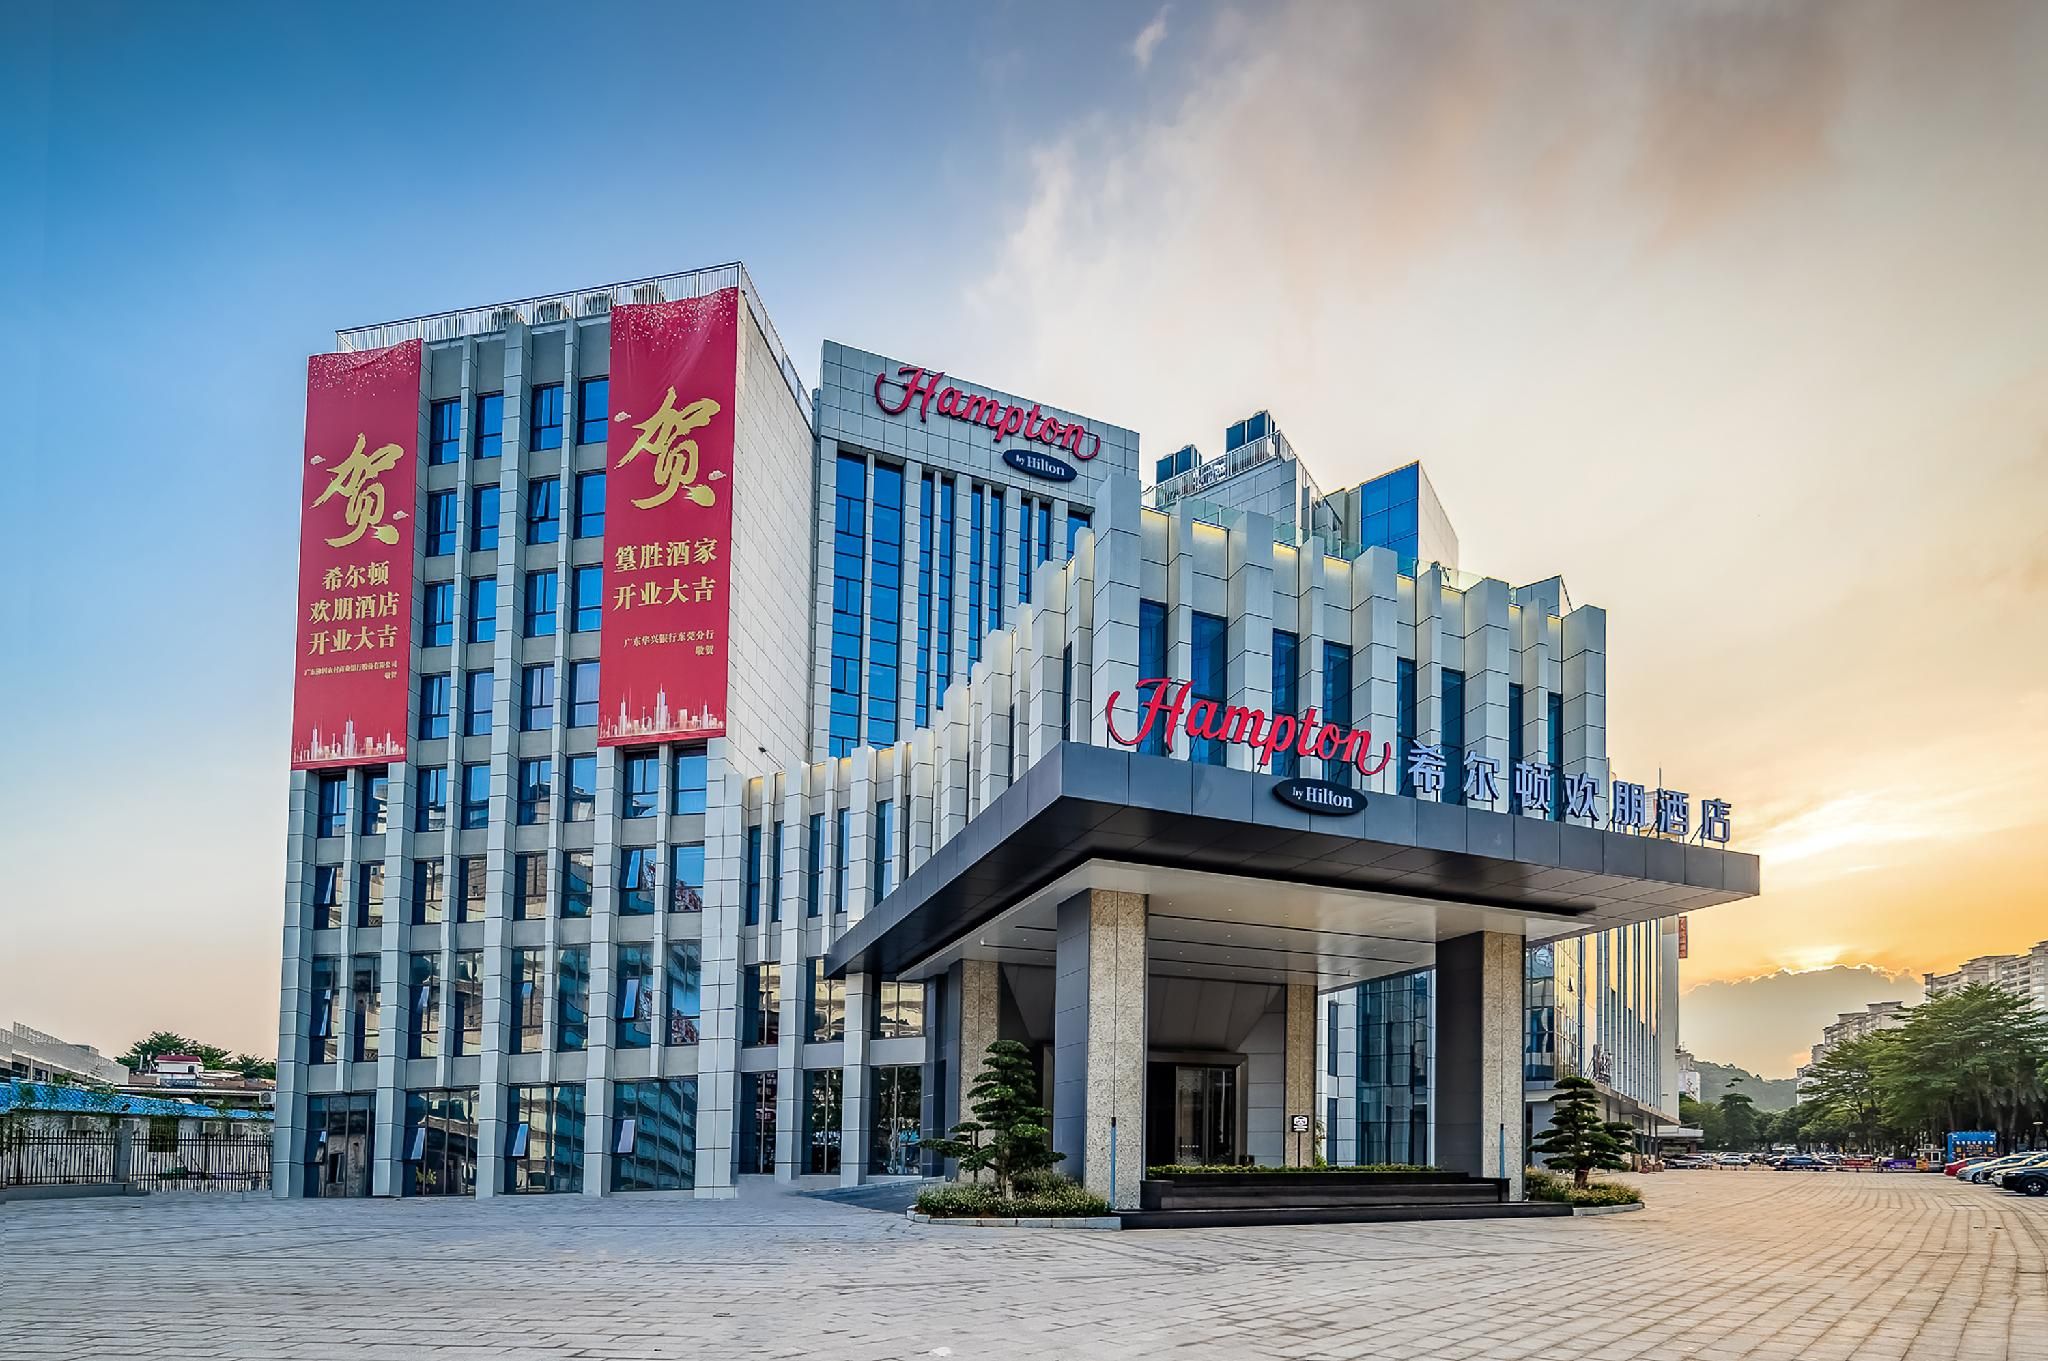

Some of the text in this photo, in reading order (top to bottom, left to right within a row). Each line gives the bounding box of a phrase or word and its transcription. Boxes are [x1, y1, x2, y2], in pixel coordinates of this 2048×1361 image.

[875, 367, 1101, 461] Hampton
[614, 385, 721, 510] 贺
[1016, 454, 1065, 476] by Hilton
[309, 432, 405, 548] 贺
[614, 537, 718, 573] 篁胜酒家
[322, 560, 390, 591] 希尔顿
[309, 591, 400, 625] 欢朋酒店
[612, 576, 717, 612] 开业大吉
[308, 624, 399, 656] 开业大吉
[1105, 677, 1391, 776] Hampton
[1292, 786, 1353, 808] by Hilton
[1407, 739, 1732, 843] 希尔顿欢朋酒店
